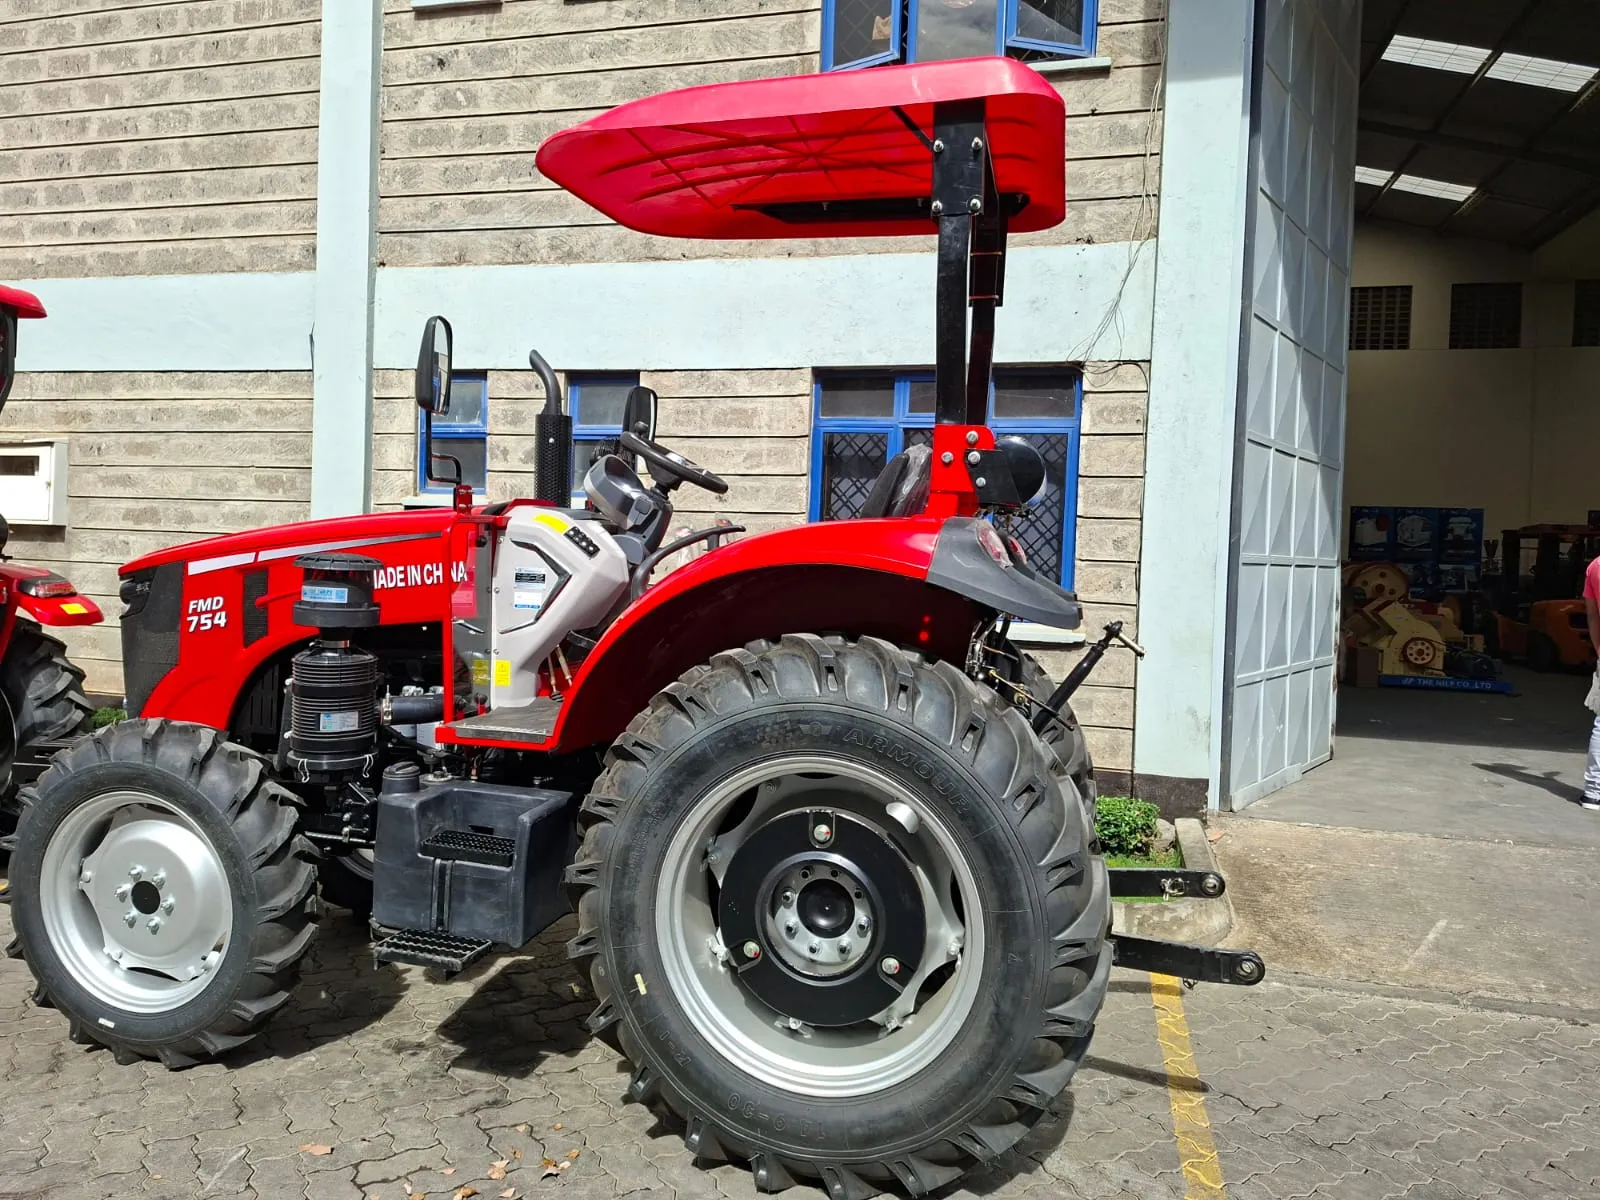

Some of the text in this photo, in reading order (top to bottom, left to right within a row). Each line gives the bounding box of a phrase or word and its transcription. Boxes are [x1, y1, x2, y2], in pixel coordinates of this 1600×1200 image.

[406, 564, 422, 587] IN
[423, 560, 468, 585] CHNA
[188, 596, 224, 615] FMD
[186, 611, 228, 633] 754
[842, 727, 971, 815] ARMOUR
